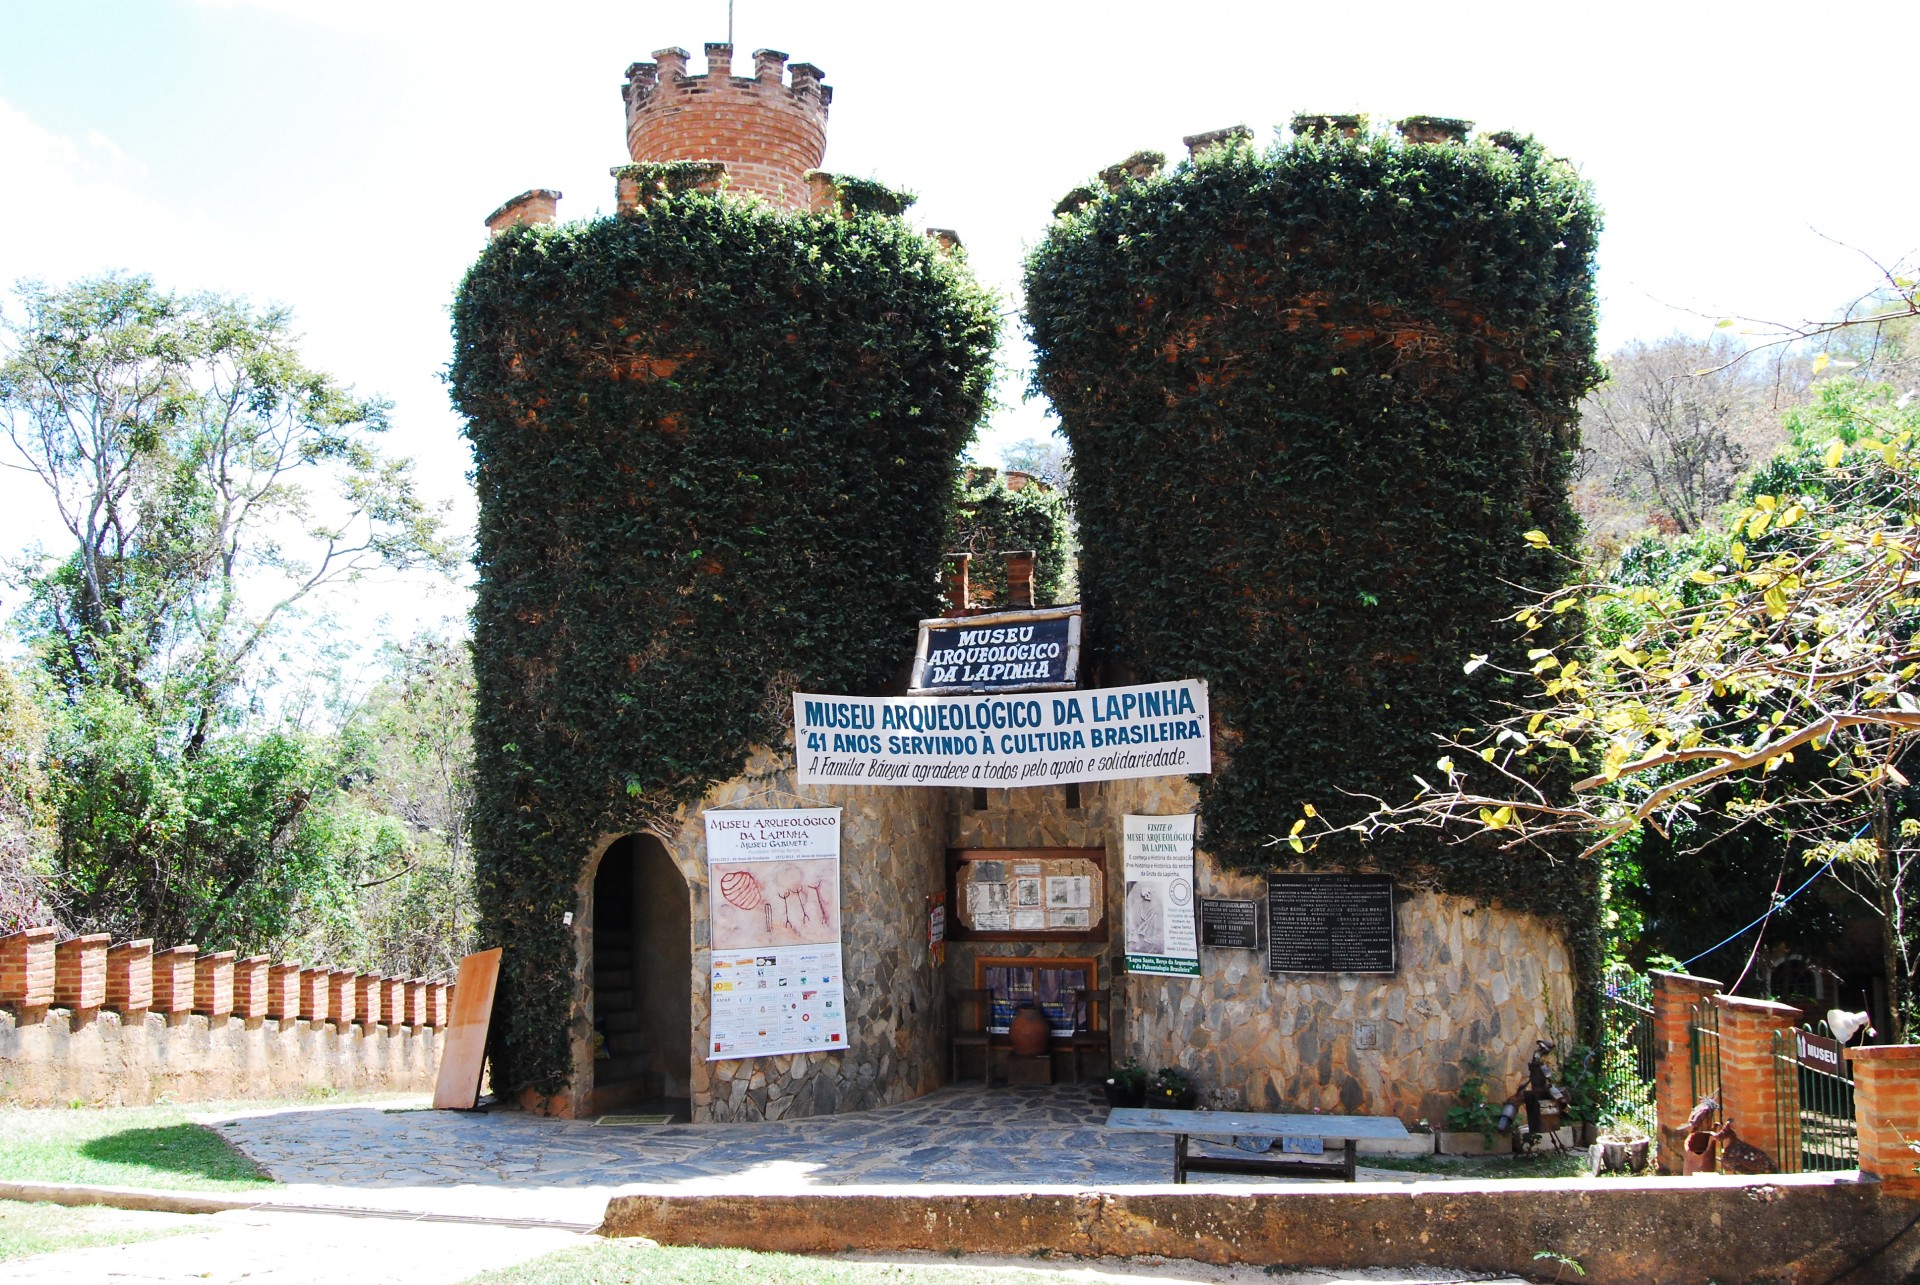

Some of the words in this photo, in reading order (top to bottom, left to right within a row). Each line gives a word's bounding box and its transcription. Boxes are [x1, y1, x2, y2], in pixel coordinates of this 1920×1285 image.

[958, 626, 1034, 647] MUSEU
[928, 643, 1060, 666] ARQUEOLÓGICO
[932, 665, 958, 683] DA
[961, 660, 1050, 682] LAPINHA
[805, 701, 875, 729] MUSEU
[882, 698, 1042, 734] ARQUEOLÓGICO
[1052, 698, 1084, 726] DA
[1092, 687, 1196, 723] LAPINHA
[833, 733, 882, 754] ANOS
[889, 735, 978, 756] SERVINDO
[982, 730, 996, 755] À
[1001, 730, 1086, 755] CULTURA
[808, 756, 819, 776] A
[820, 756, 865, 777] Família
[911, 760, 969, 782] agradece
[972, 766, 982, 780] a
[983, 760, 1018, 780] todos
[1021, 757, 1047, 781] pelo
[1050, 756, 1083, 778] apoio
[1087, 760, 1095, 772] e
[1098, 746, 1190, 771] solidariedade.
[760, 829, 810, 841] LAPINHA
[1126, 833, 1145, 842] MUSEU
[1147, 823, 1167, 832] VISITE
[1167, 823, 1173, 832] O
[1141, 843, 1150, 853] DA
[1150, 843, 1178, 853] LAPINHA
[1807, 1043, 1838, 1065] MUSEU
